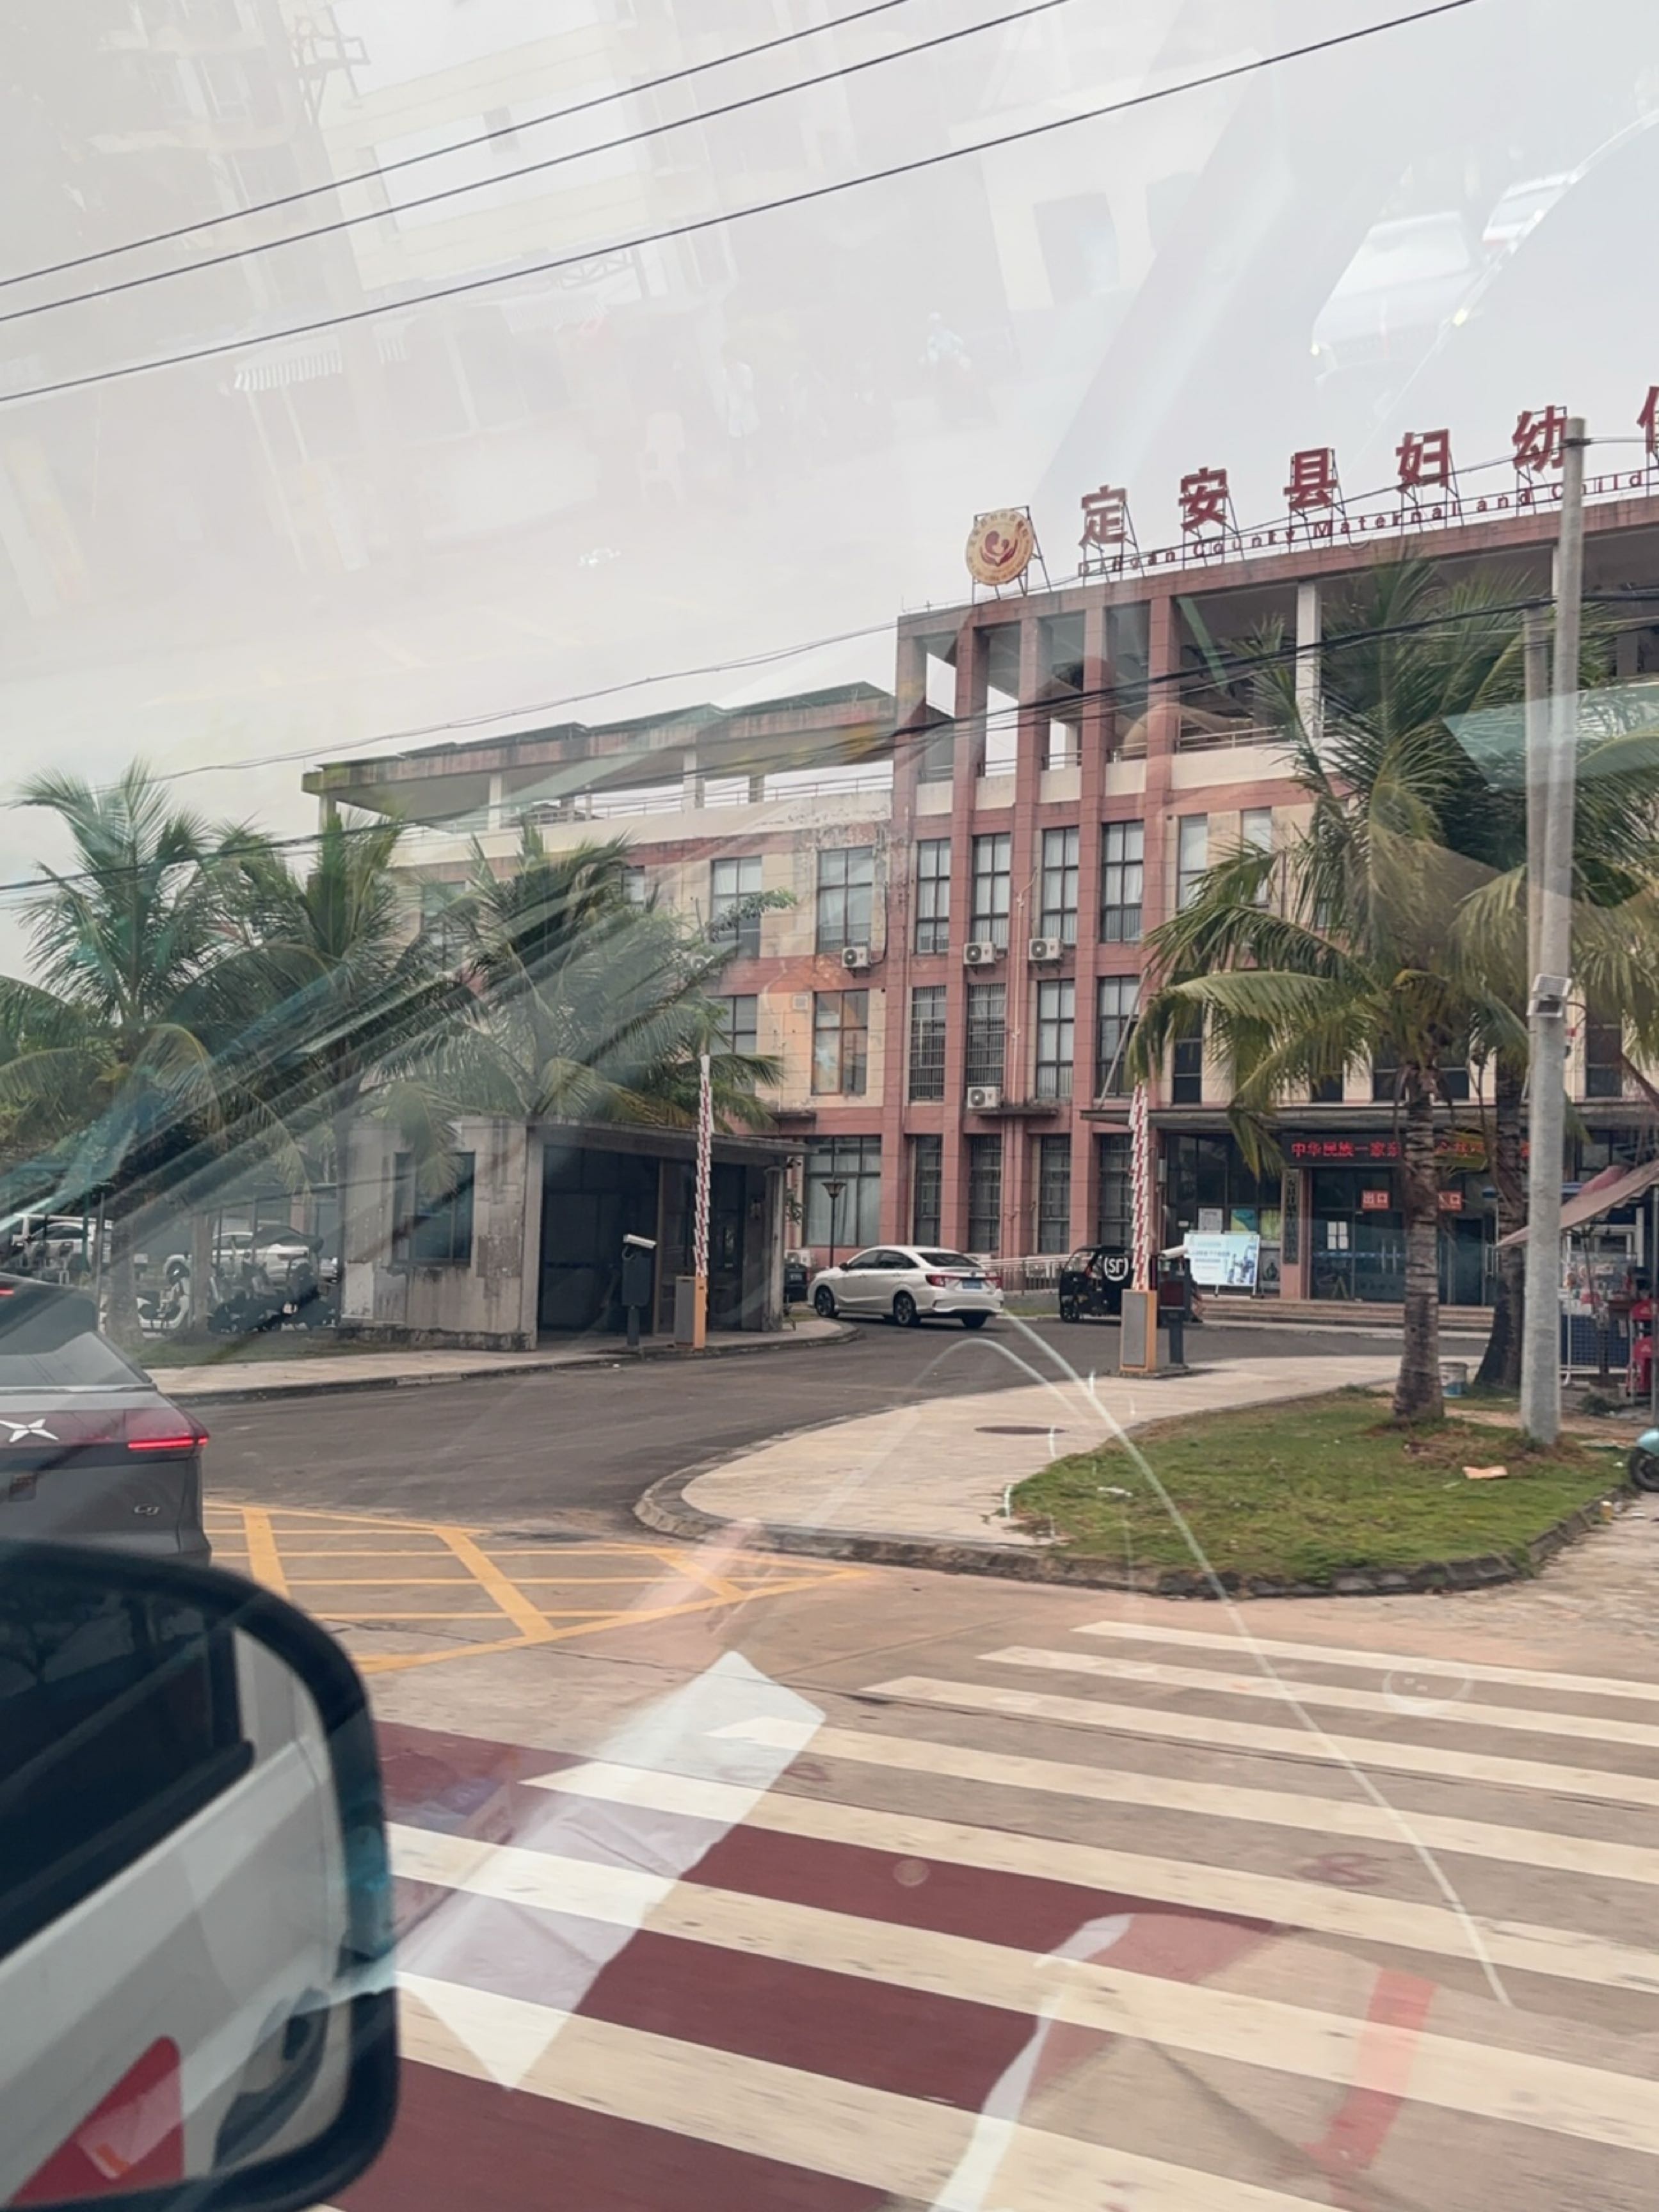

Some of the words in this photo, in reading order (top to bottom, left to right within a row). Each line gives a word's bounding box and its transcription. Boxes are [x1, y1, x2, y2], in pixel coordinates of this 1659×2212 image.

[1193, 529, 1295, 557] County
[1313, 501, 1461, 538] Maternal
[1477, 488, 1532, 512] and
[1551, 470, 1642, 500] Cild
[1363, 1192, 1388, 1204] 出口
